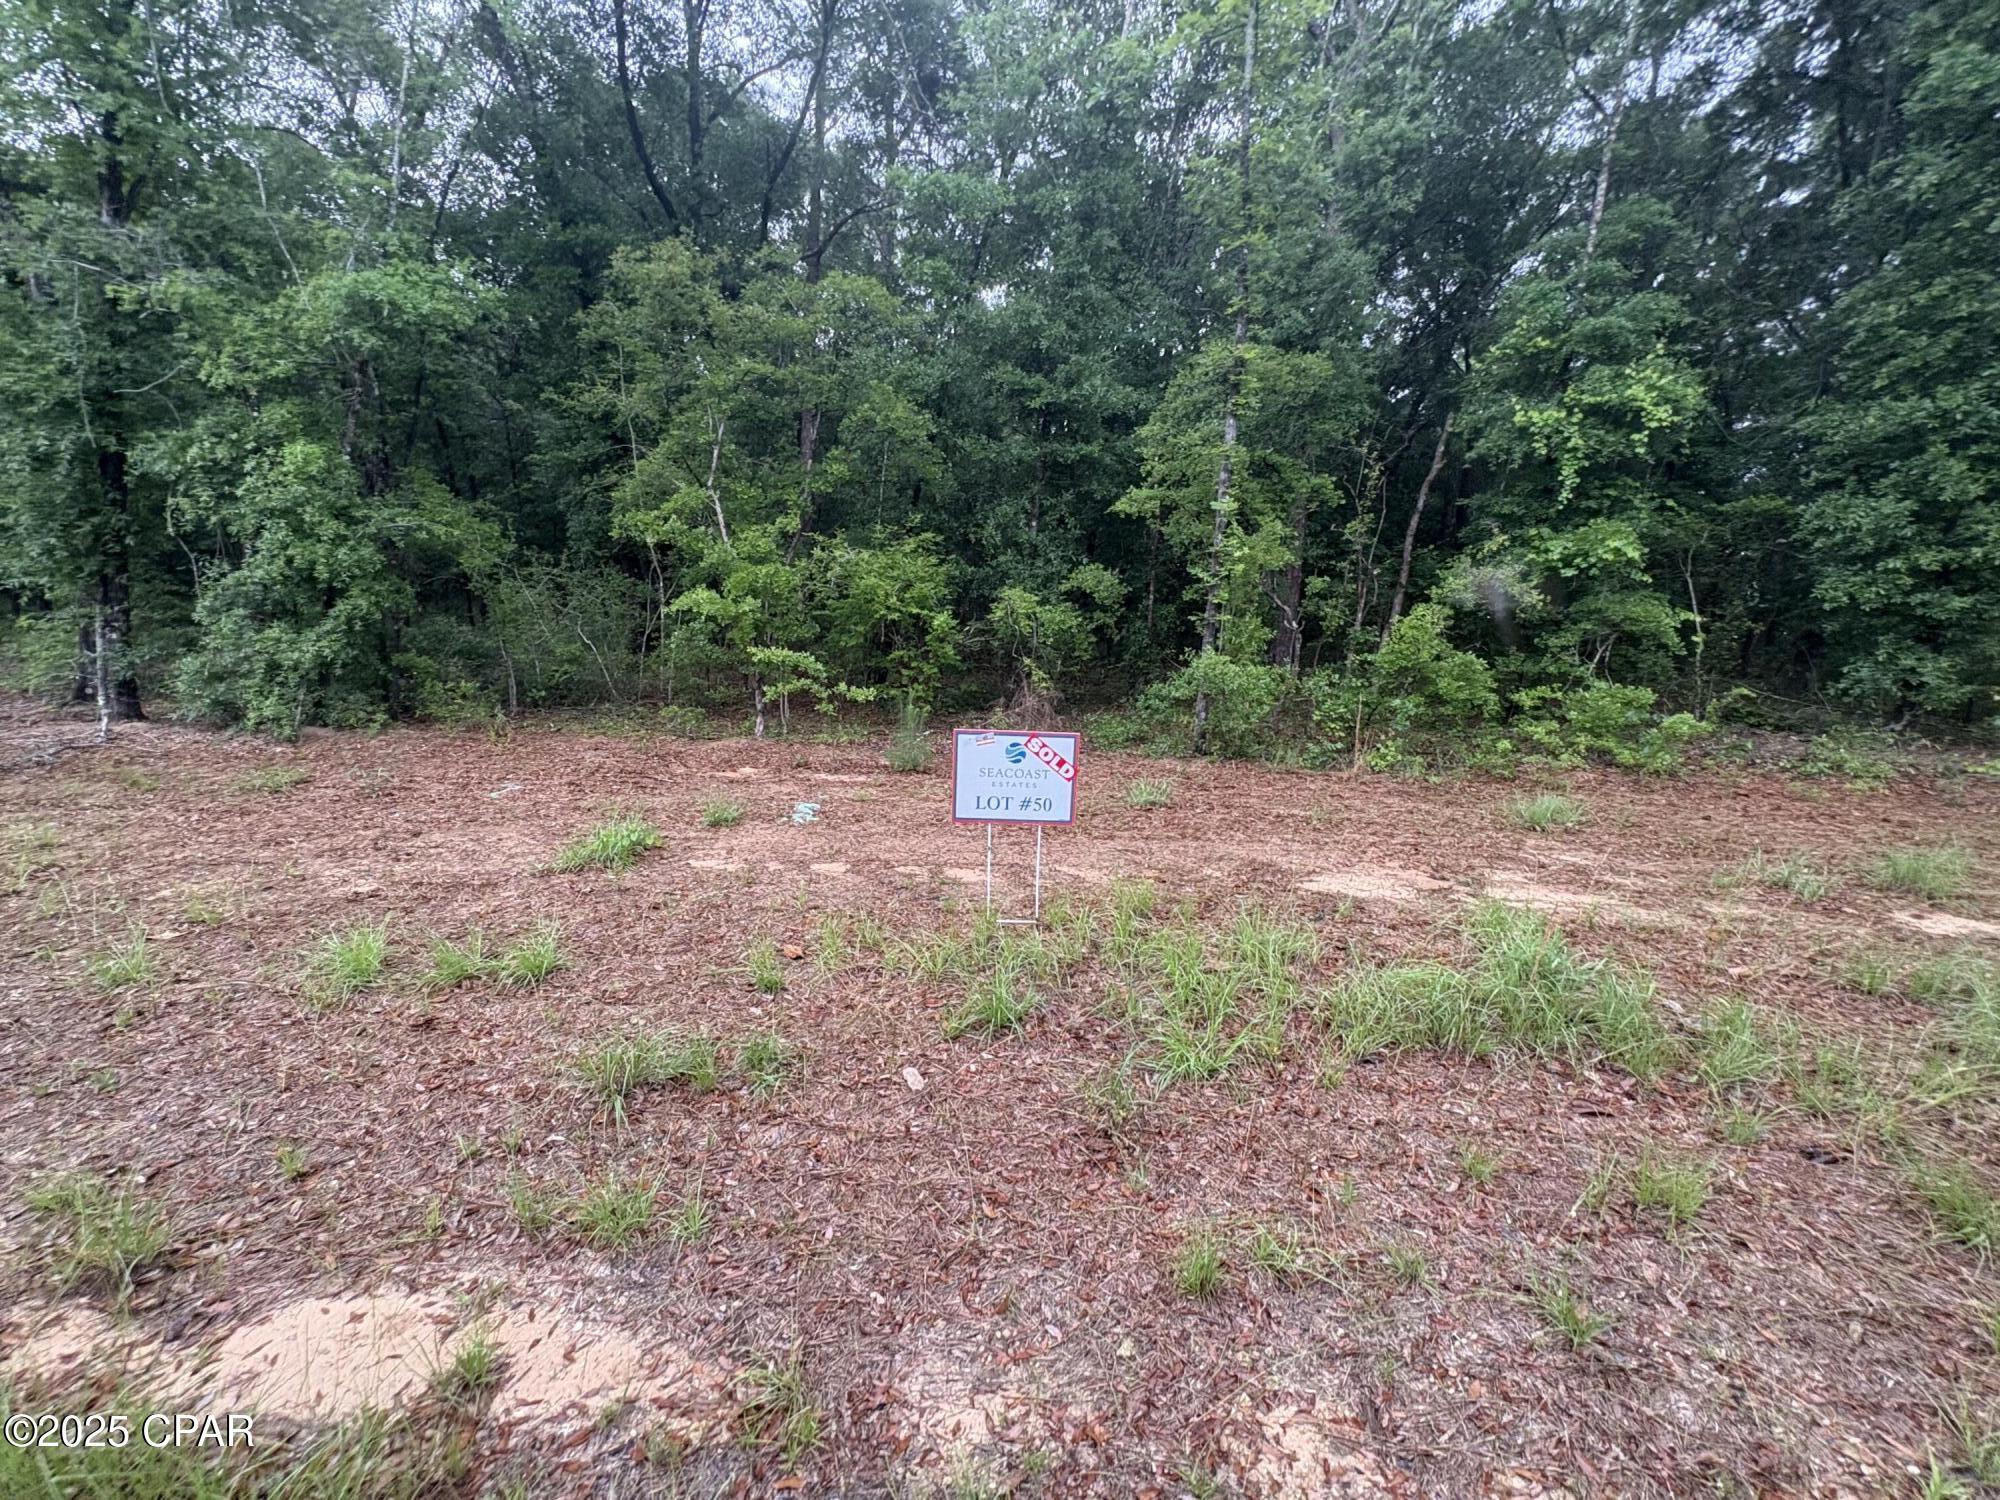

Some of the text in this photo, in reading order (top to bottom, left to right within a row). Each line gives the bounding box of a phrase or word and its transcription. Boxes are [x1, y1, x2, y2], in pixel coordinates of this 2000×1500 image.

[1027, 737, 1075, 779] SOLD
[979, 767, 1050, 780] SEACOAST
[991, 781, 1037, 789] ESTATES
[975, 795, 1052, 812] LOT #50
